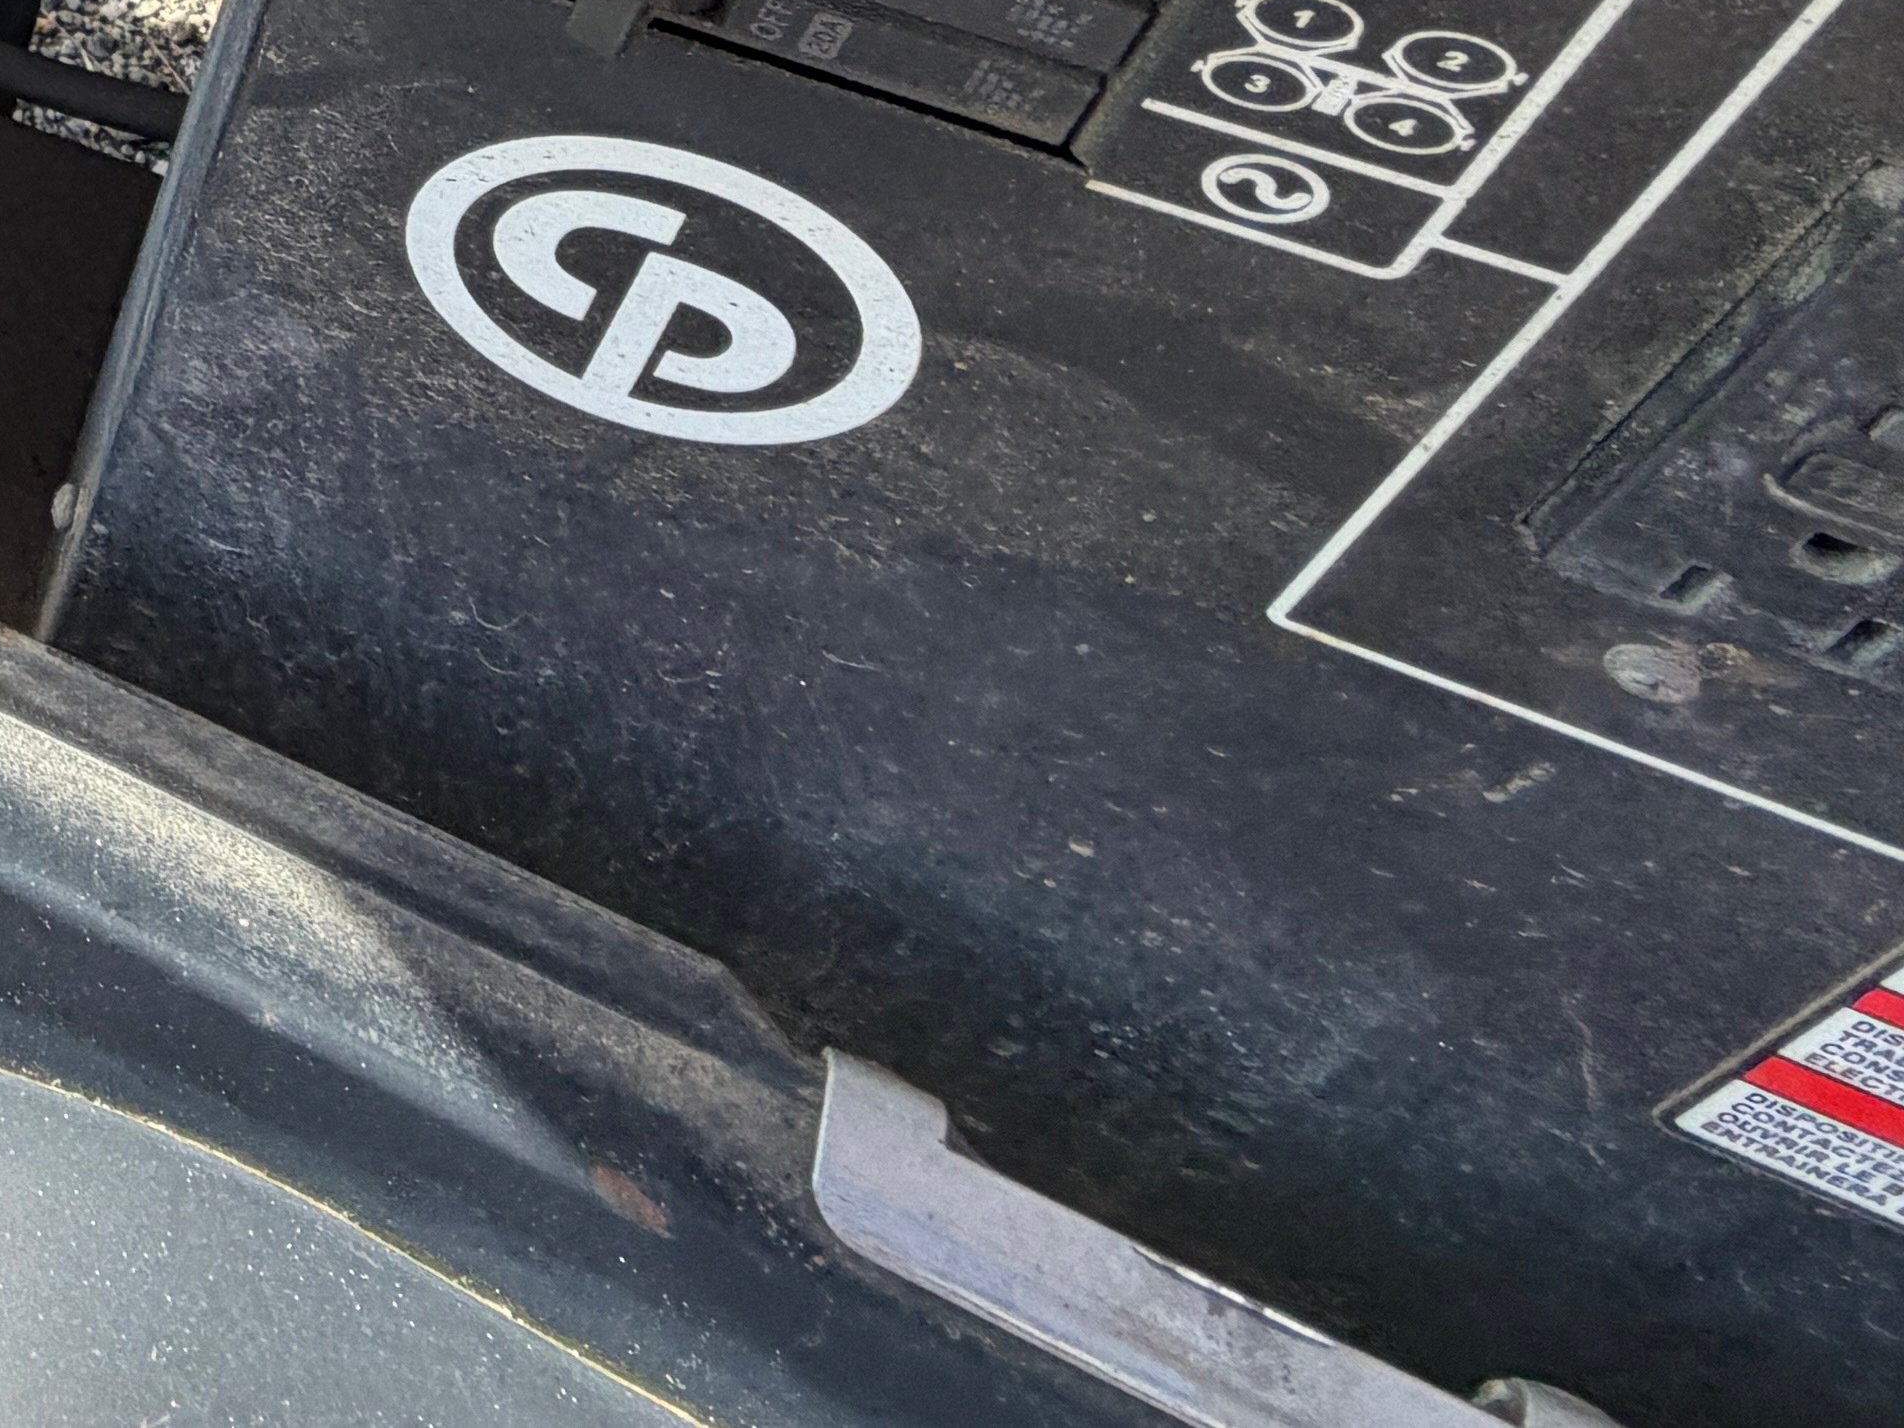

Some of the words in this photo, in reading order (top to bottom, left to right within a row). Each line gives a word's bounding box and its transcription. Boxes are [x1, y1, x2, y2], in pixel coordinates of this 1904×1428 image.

[1293, 9, 1316, 29] 1
[1436, 50, 1471, 73] 2
[1244, 74, 1272, 95] 3
[1388, 118, 1420, 137] 4
[1833, 1162, 1878, 1184] LE
